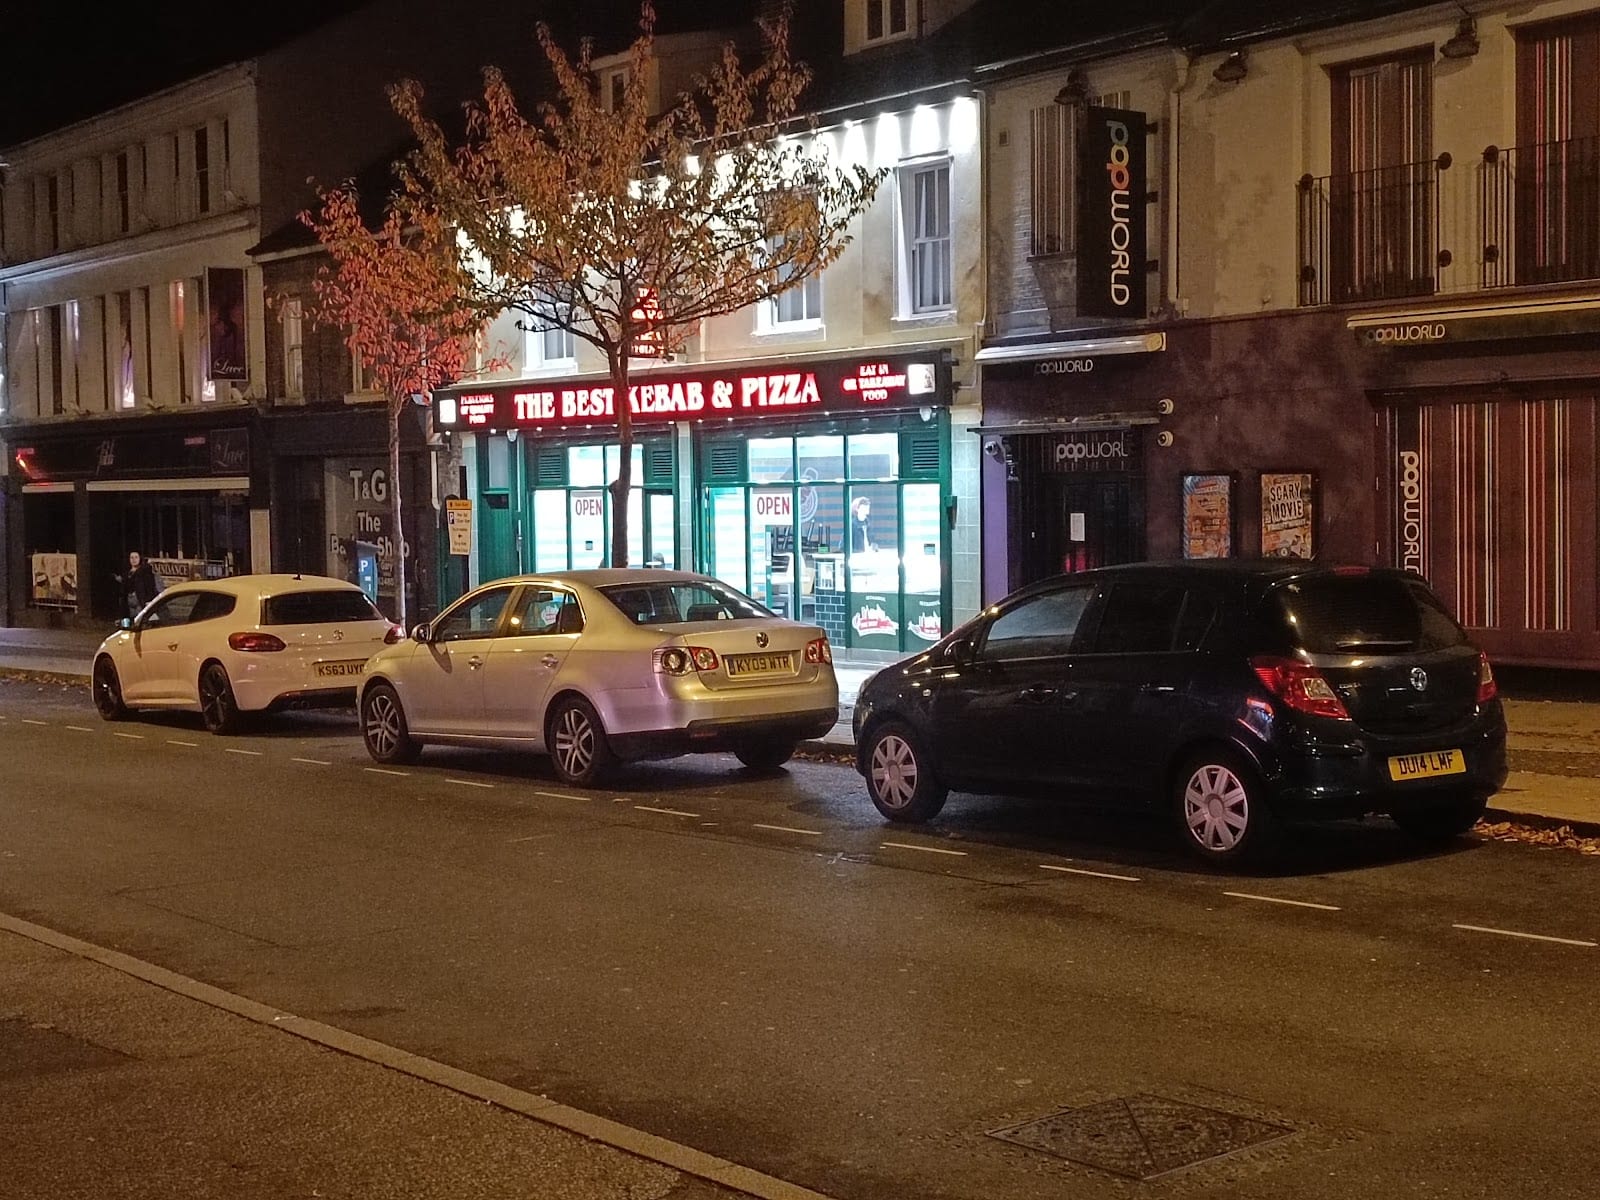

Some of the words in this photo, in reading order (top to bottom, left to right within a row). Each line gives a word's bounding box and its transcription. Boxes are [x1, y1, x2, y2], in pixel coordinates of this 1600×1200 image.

[860, 365, 877, 376] EAT
[878, 364, 889, 375] IN
[514, 392, 555, 420] THE
[561, 388, 615, 418] BEST
[711, 380, 734, 409] &
[741, 373, 821, 408] PIZZA
[862, 389, 888, 401] FOOD
[1269, 482, 1301, 502] SCARY
[575, 498, 602, 516] OPEN
[757, 496, 790, 516] OPEN
[1271, 500, 1303, 521] MOVIE
[356, 511, 381, 533] The
[376, 536, 410, 559] Shp
[318, 665, 345, 677] KS63
[736, 657, 767, 673] KY09
[1396, 755, 1428, 775] DU14
